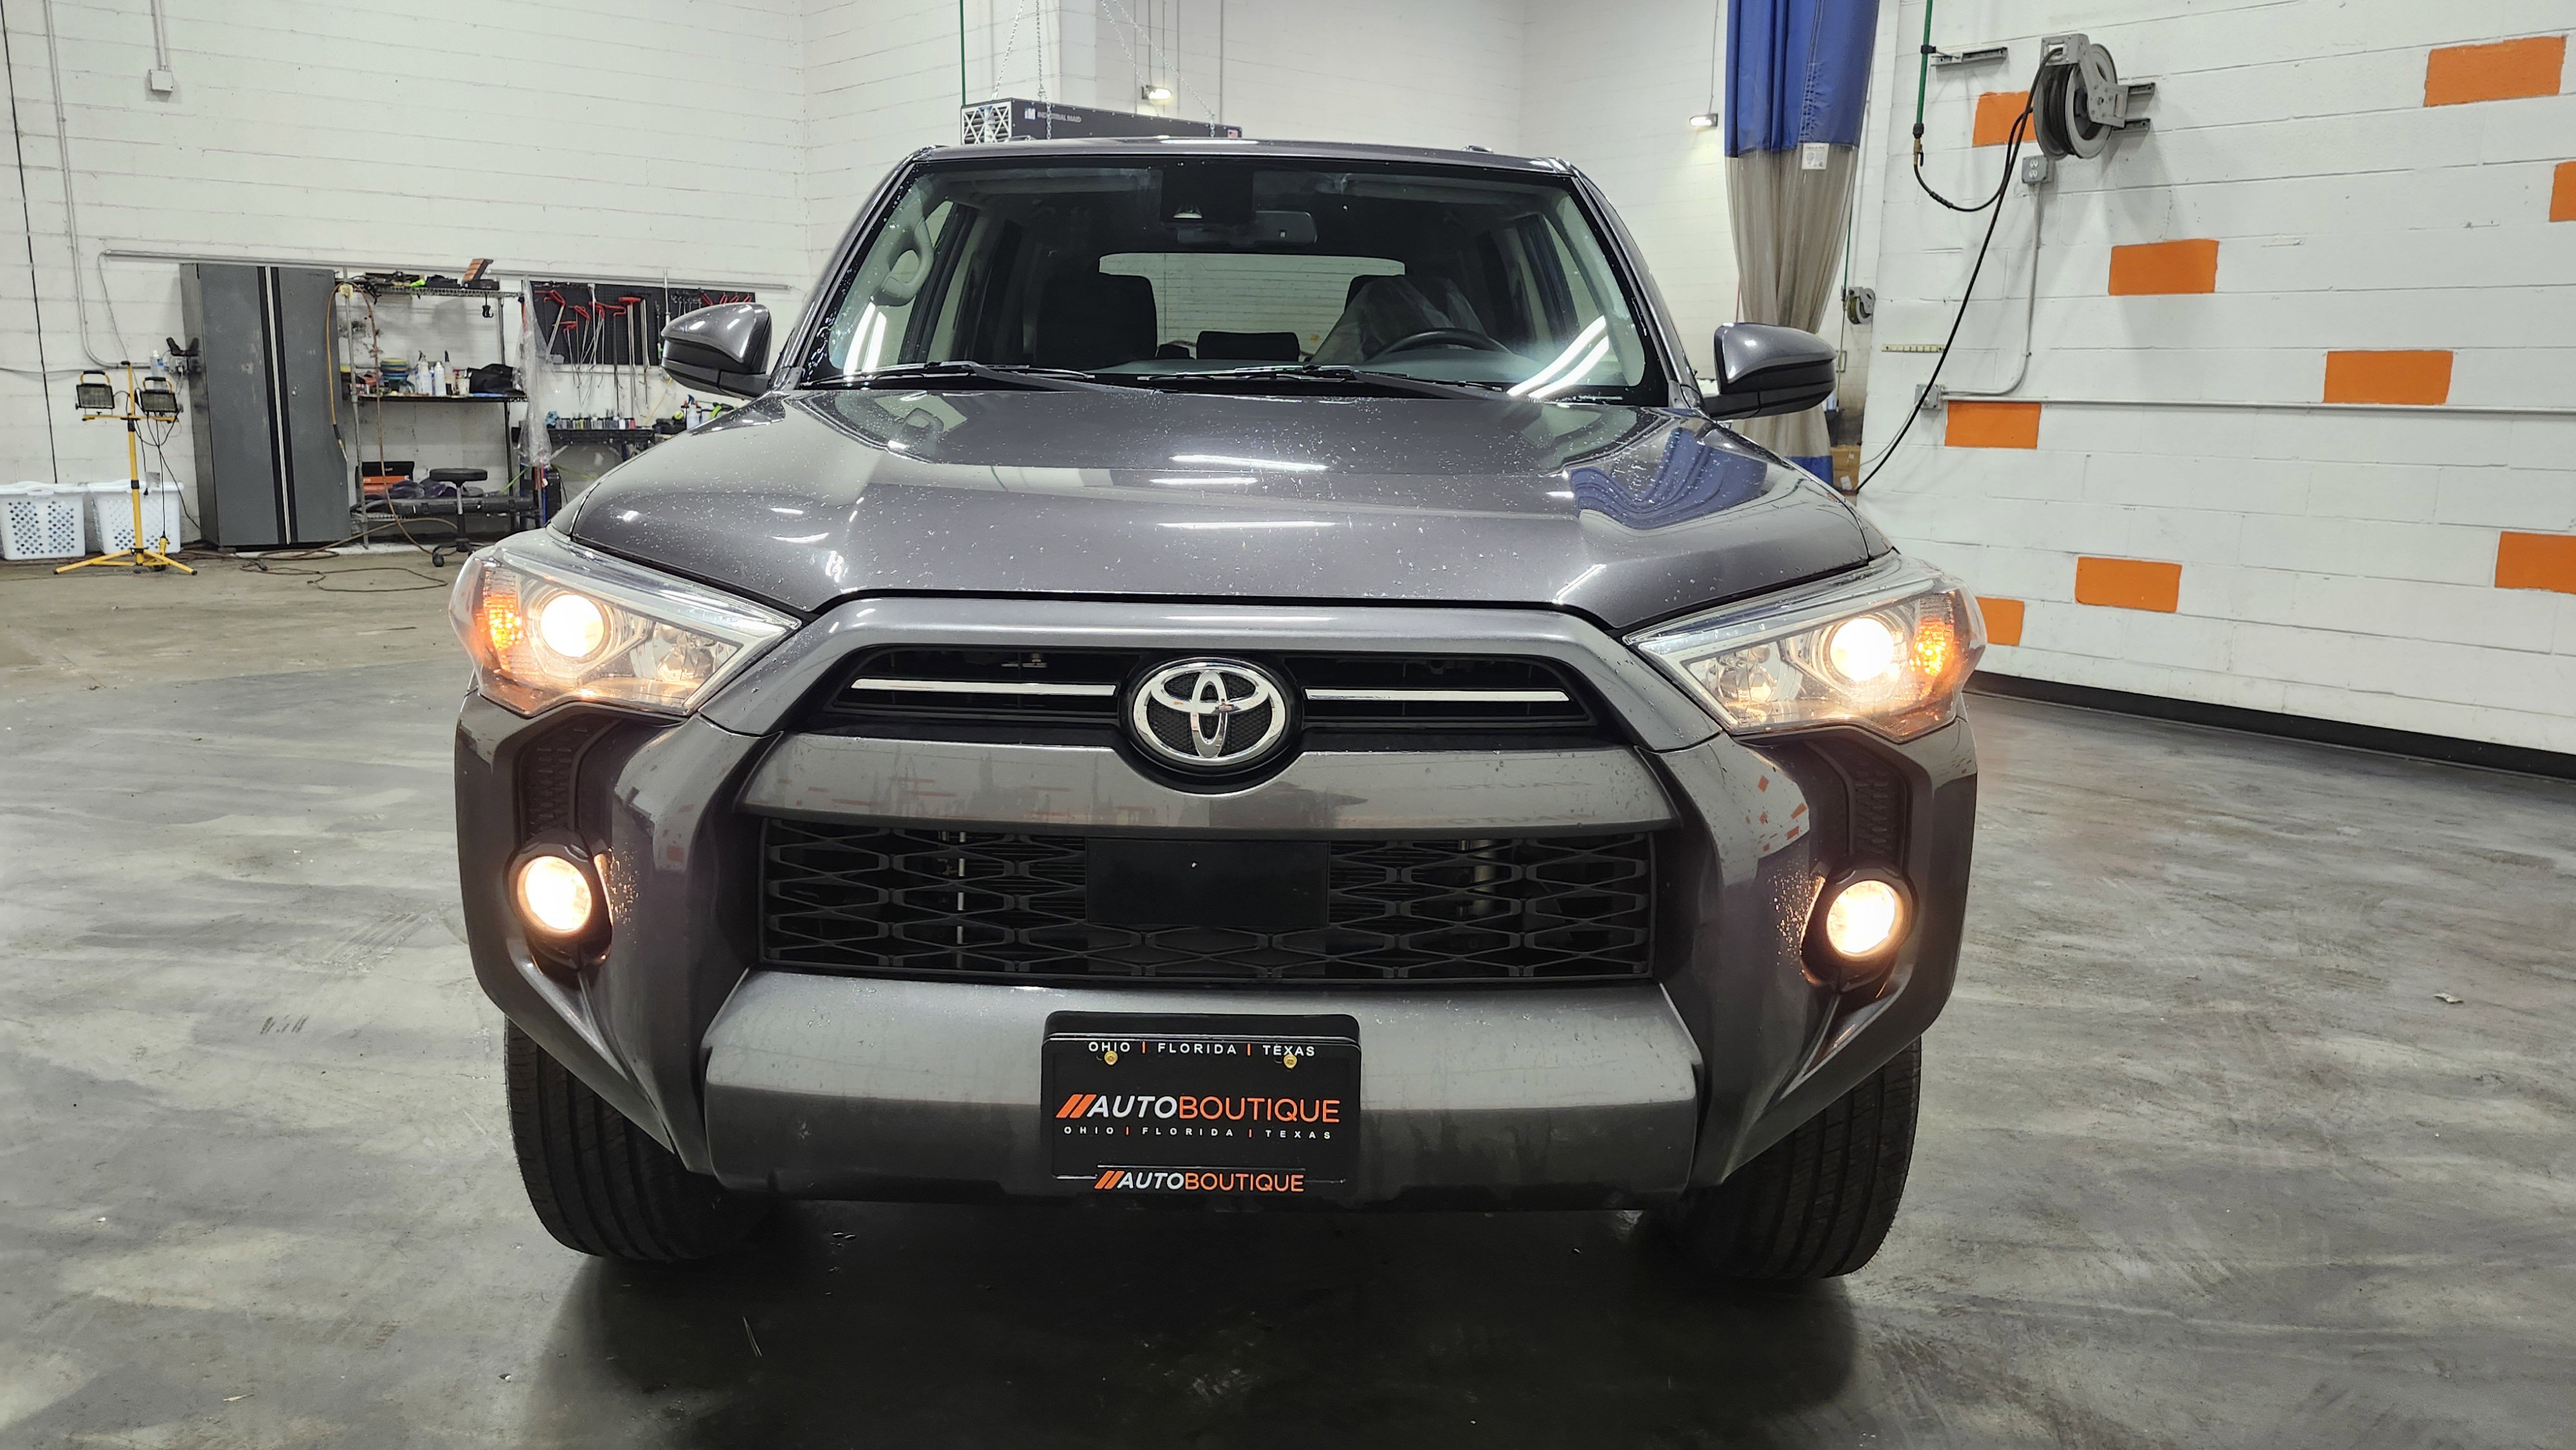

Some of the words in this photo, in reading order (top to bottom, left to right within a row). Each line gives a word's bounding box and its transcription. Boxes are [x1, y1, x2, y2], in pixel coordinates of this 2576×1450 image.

[1088, 1041, 1130, 1053] OHIO
[1157, 1042, 1236, 1055] FLORIDA
[1263, 1044, 1315, 1057] TEXAS
[1086, 1095, 1341, 1123] AUTOBOUTIQUE
[1142, 1127, 1233, 1136] FLORIDA
[1265, 1129, 1331, 1139] TEXAS
[1117, 1172, 1305, 1192] AUTOBOUTIQUE
